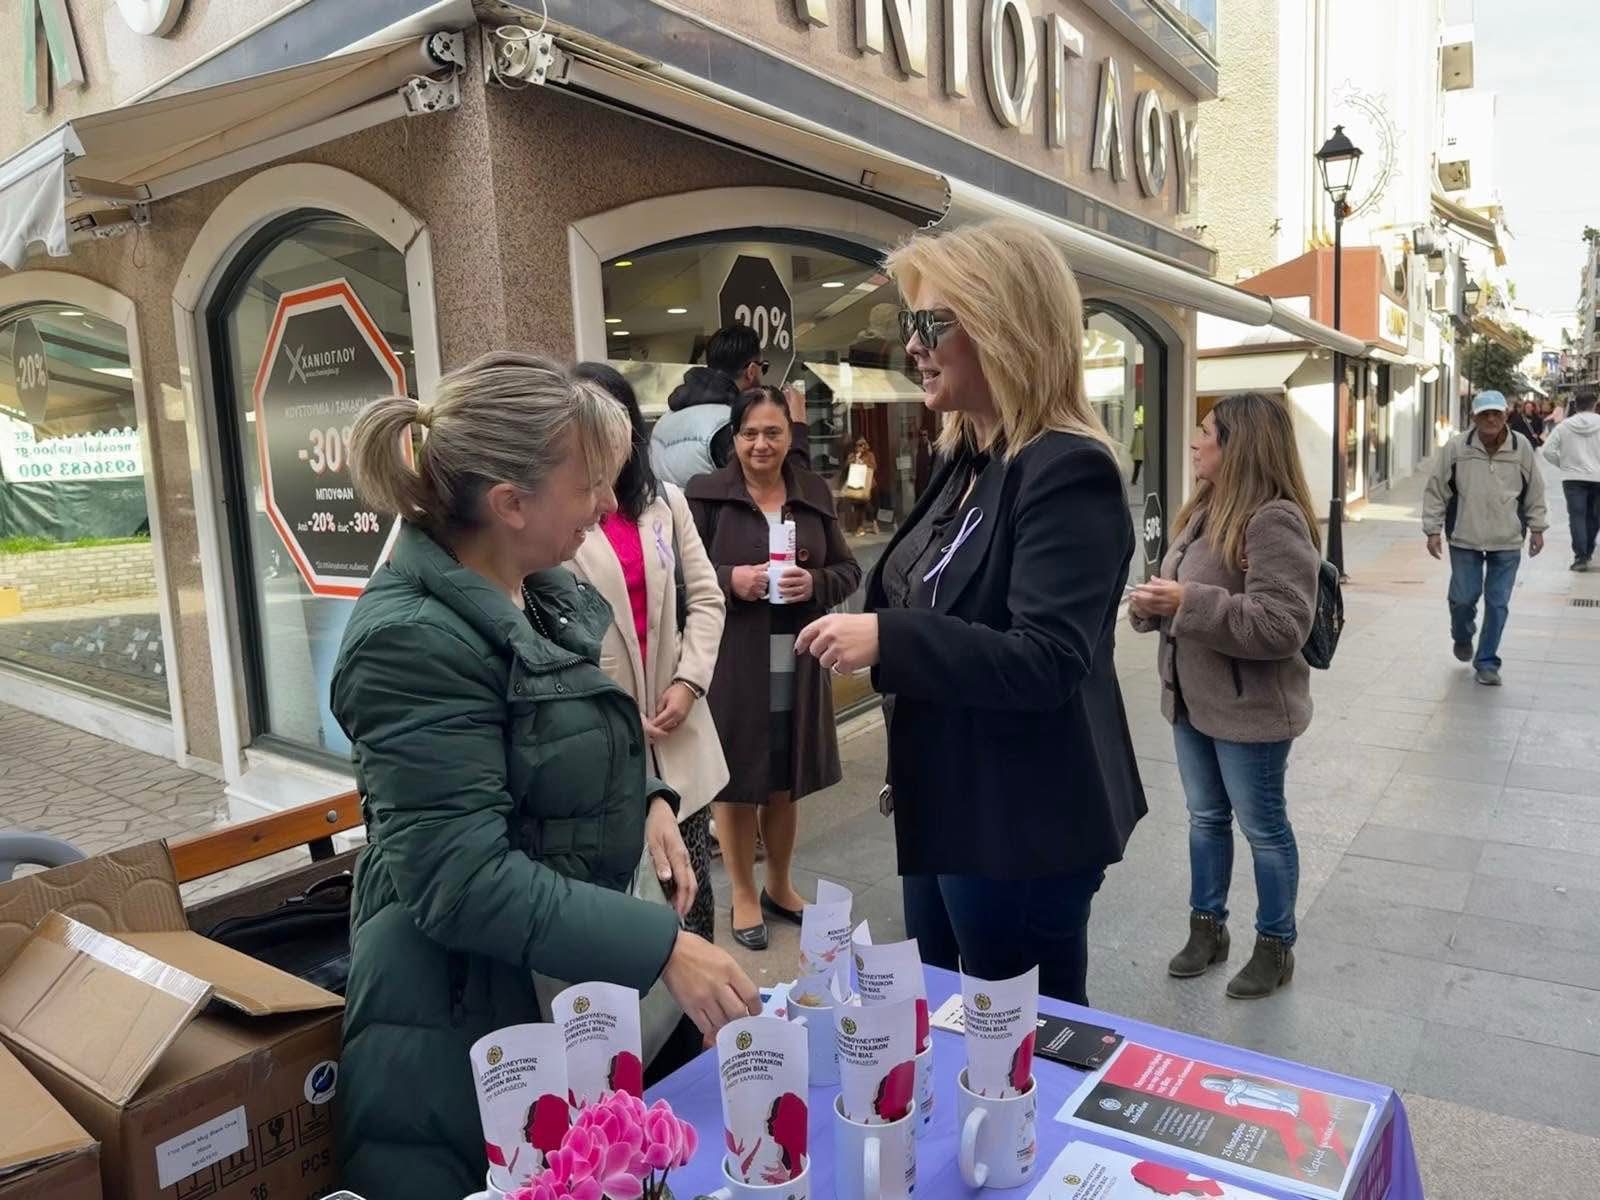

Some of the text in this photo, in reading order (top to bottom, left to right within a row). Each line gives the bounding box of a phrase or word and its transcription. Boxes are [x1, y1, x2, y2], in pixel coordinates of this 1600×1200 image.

[795, 0, 1198, 214] ΝΙΟΓΛΟΥ
[301, 347, 356, 369] ΧΑΝΙΟΓΛΟΥ
[16, 353, 46, 390] -20%
[315, 488, 354, 500] ΜΠΟΥΦΑΝ
[308, 512, 336, 532] -20%
[349, 512, 379, 533] -30%
